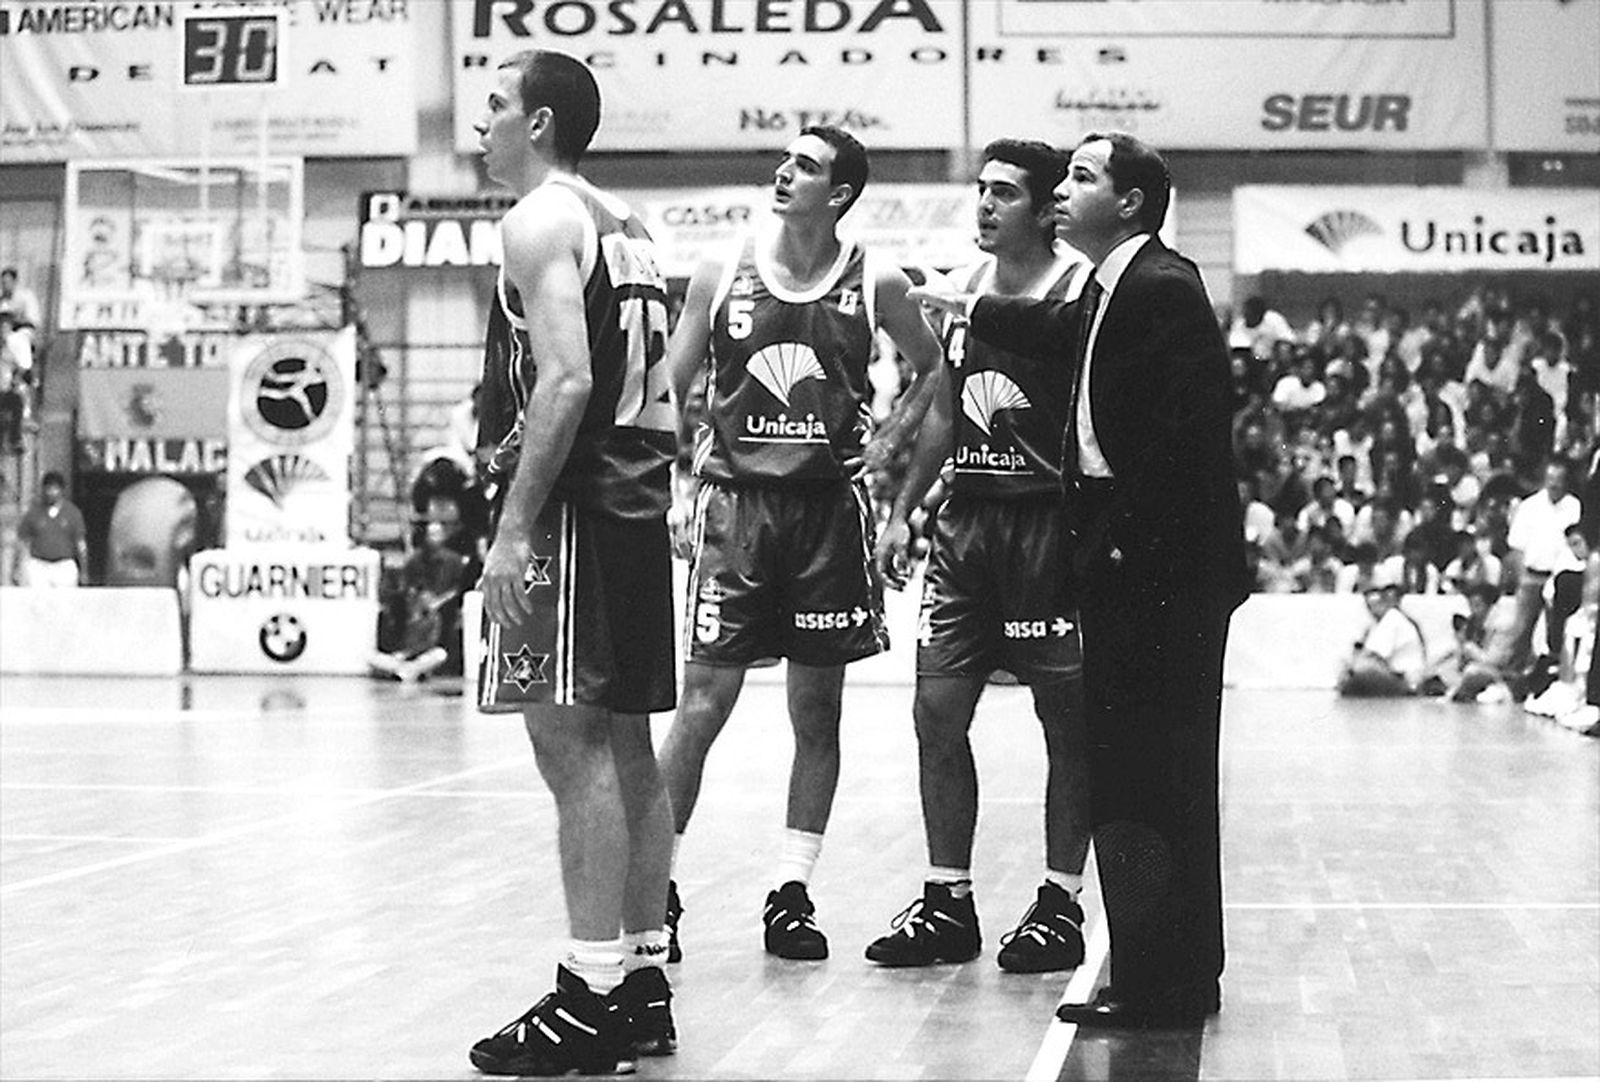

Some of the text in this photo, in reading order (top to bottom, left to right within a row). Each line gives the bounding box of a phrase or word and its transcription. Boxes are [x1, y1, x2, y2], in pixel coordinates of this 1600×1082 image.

[17, 5, 173, 34] AMERICAN
[473, 0, 944, 37] ROSALEDA
[187, 22, 276, 82] 30
[1261, 94, 1411, 131] SEUR
[1402, 215, 1585, 262] Unicaja
[728, 300, 755, 340] 5
[746, 413, 827, 441] Unicaja
[956, 444, 1026, 471] Unicaja
[201, 564, 369, 599] GUARNIERI
[696, 602, 721, 644] 5
